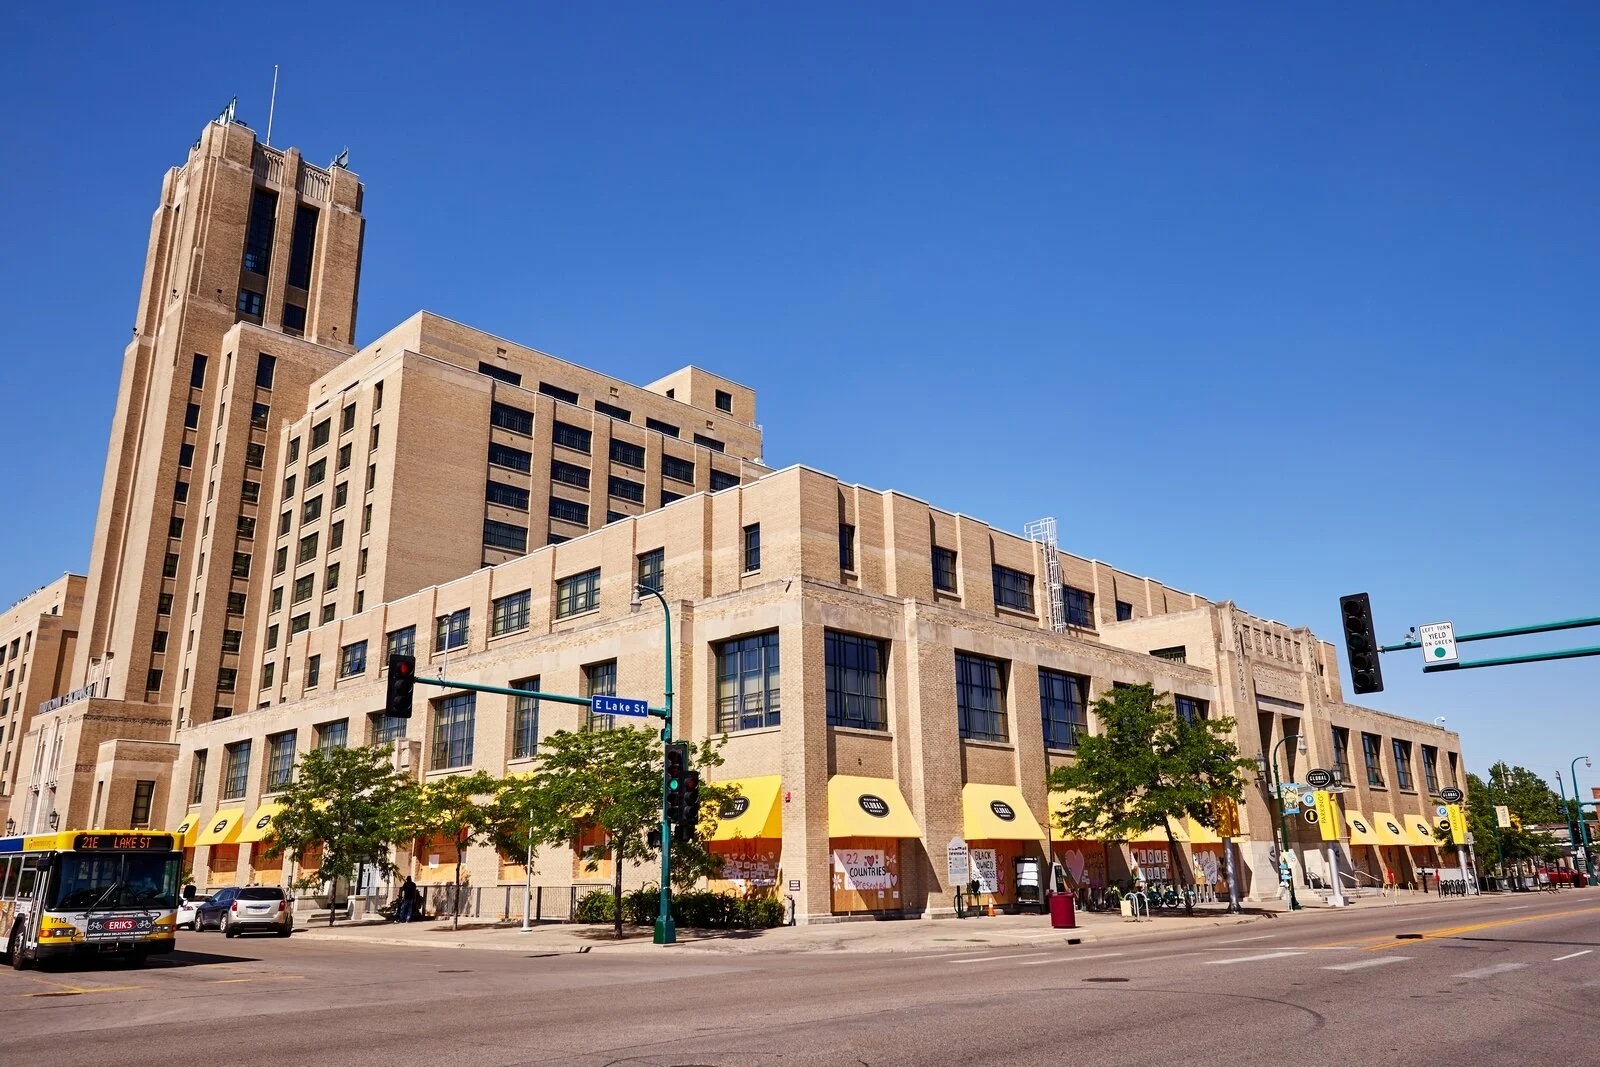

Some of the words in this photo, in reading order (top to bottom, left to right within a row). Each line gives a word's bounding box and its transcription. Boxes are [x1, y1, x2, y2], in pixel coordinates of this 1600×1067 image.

[1428, 631, 1446, 640] YIELD
[595, 700, 602, 709] E
[605, 701, 631, 712] Lake
[634, 704, 645, 713] St
[863, 801, 884, 810] GLOBAL
[81, 836, 99, 849] 21E
[113, 837, 137, 849] LAKE
[139, 837, 152, 849] ST
[846, 852, 858, 865] 22
[974, 851, 991, 860] BLACK
[1141, 851, 1168, 862] LOVE
[976, 860, 993, 869] OWNED
[849, 866, 887, 878] COUNTRIES
[50, 917, 67, 925] 1713
[108, 920, 133, 930] ERIK'S
